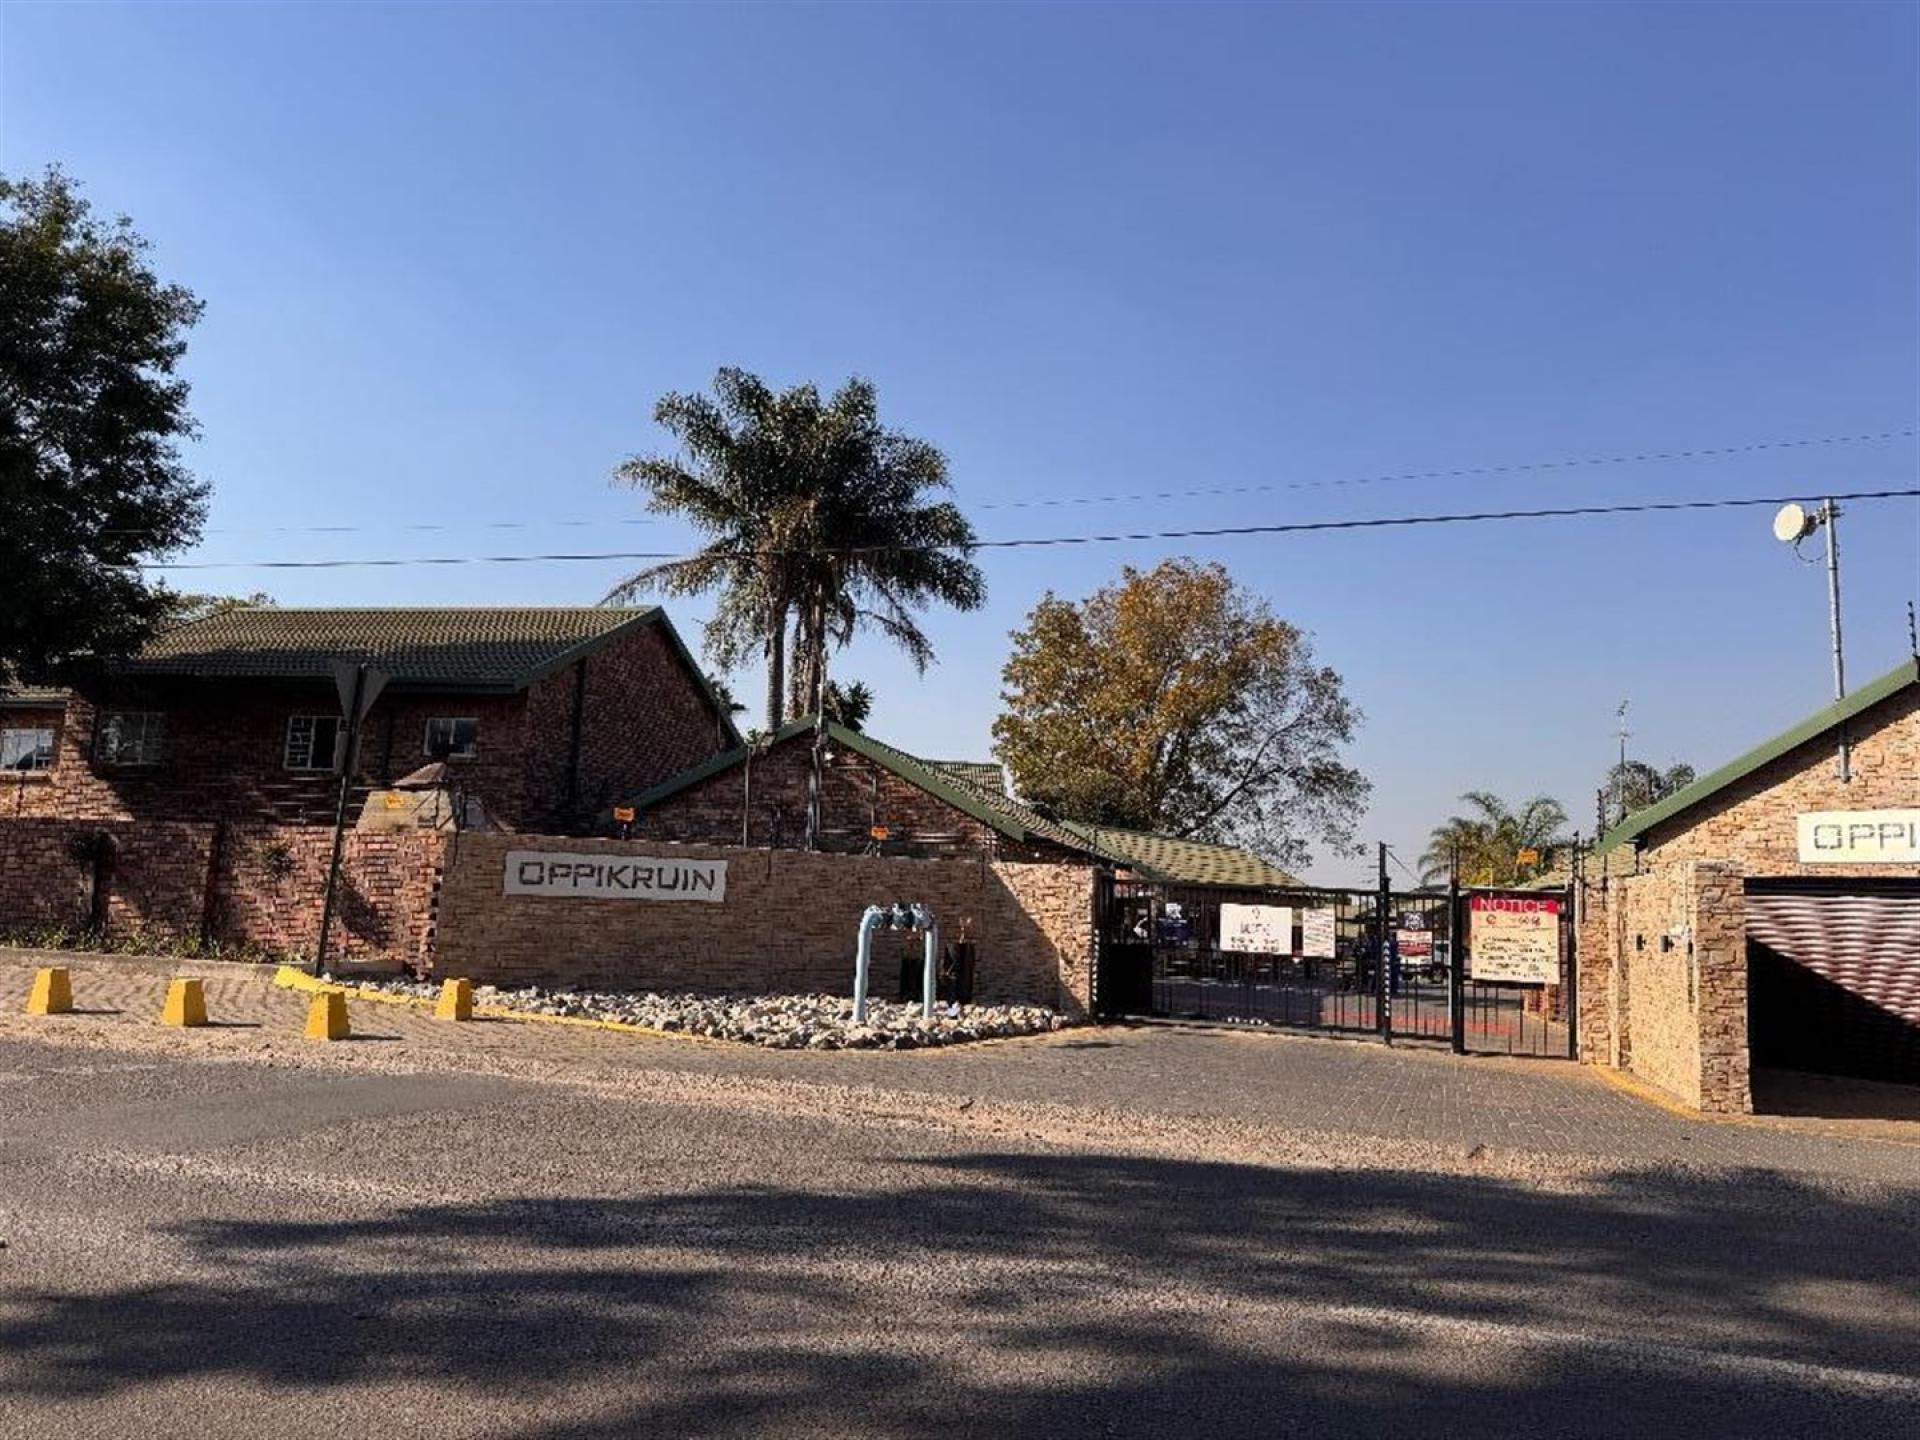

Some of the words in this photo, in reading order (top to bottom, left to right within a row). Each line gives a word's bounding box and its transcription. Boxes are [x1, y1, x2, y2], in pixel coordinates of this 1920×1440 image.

[1813, 823, 1917, 850] OPPI
[518, 861, 716, 892] OPPIKRUIN
[1479, 898, 1548, 913] NOTICE
